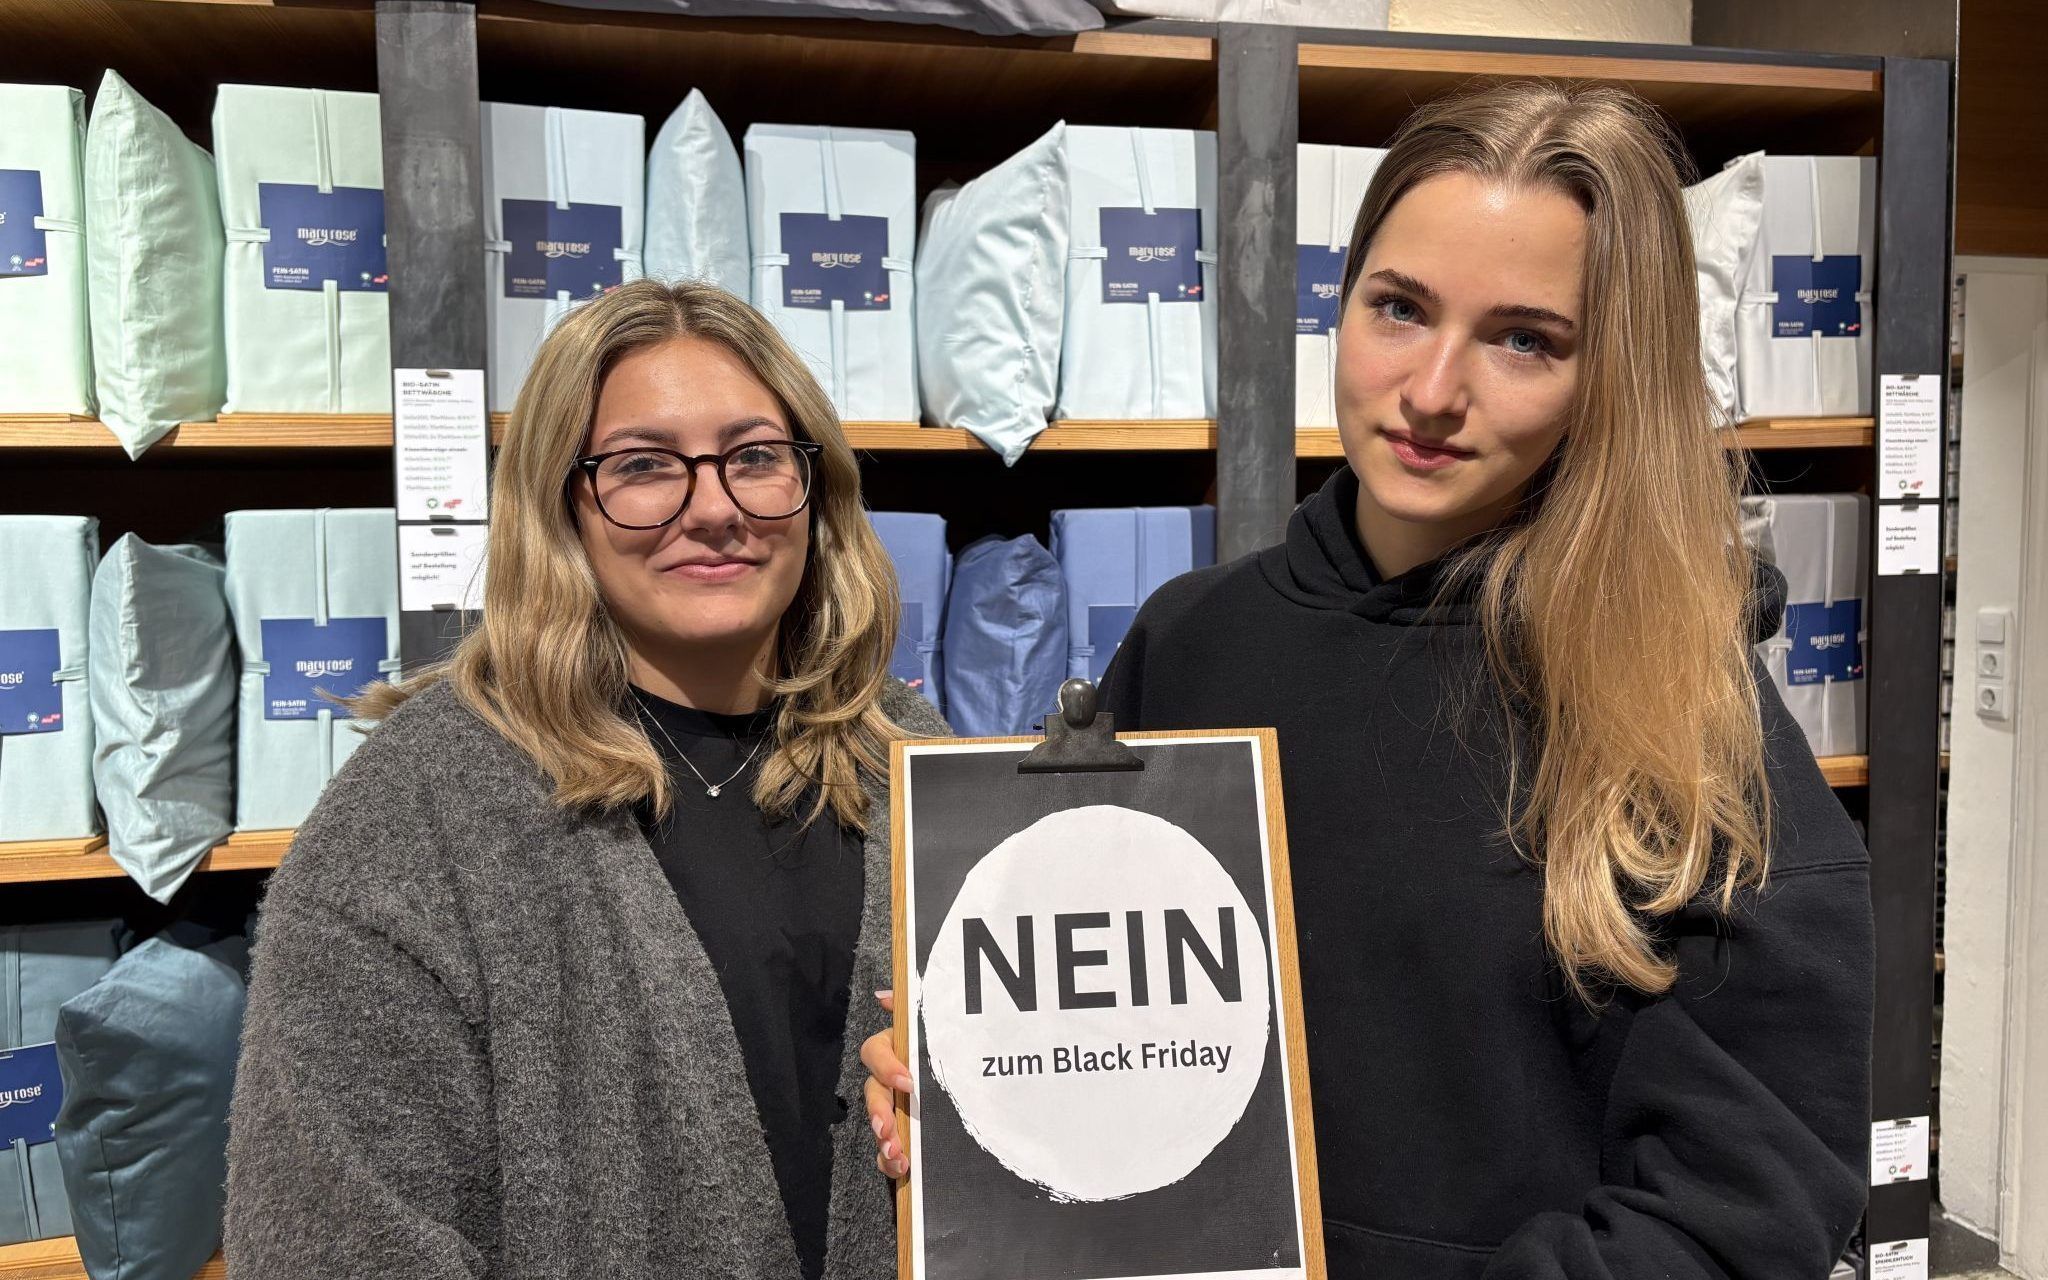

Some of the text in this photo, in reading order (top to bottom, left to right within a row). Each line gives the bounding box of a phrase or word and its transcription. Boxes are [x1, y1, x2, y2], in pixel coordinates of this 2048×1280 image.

[297, 228, 328, 246] mary
[0, 671, 24, 684] ose
[296, 660, 325, 678] mary
[962, 906, 1242, 1015] NEIN
[982, 1039, 1232, 1077] zum Black Friday
